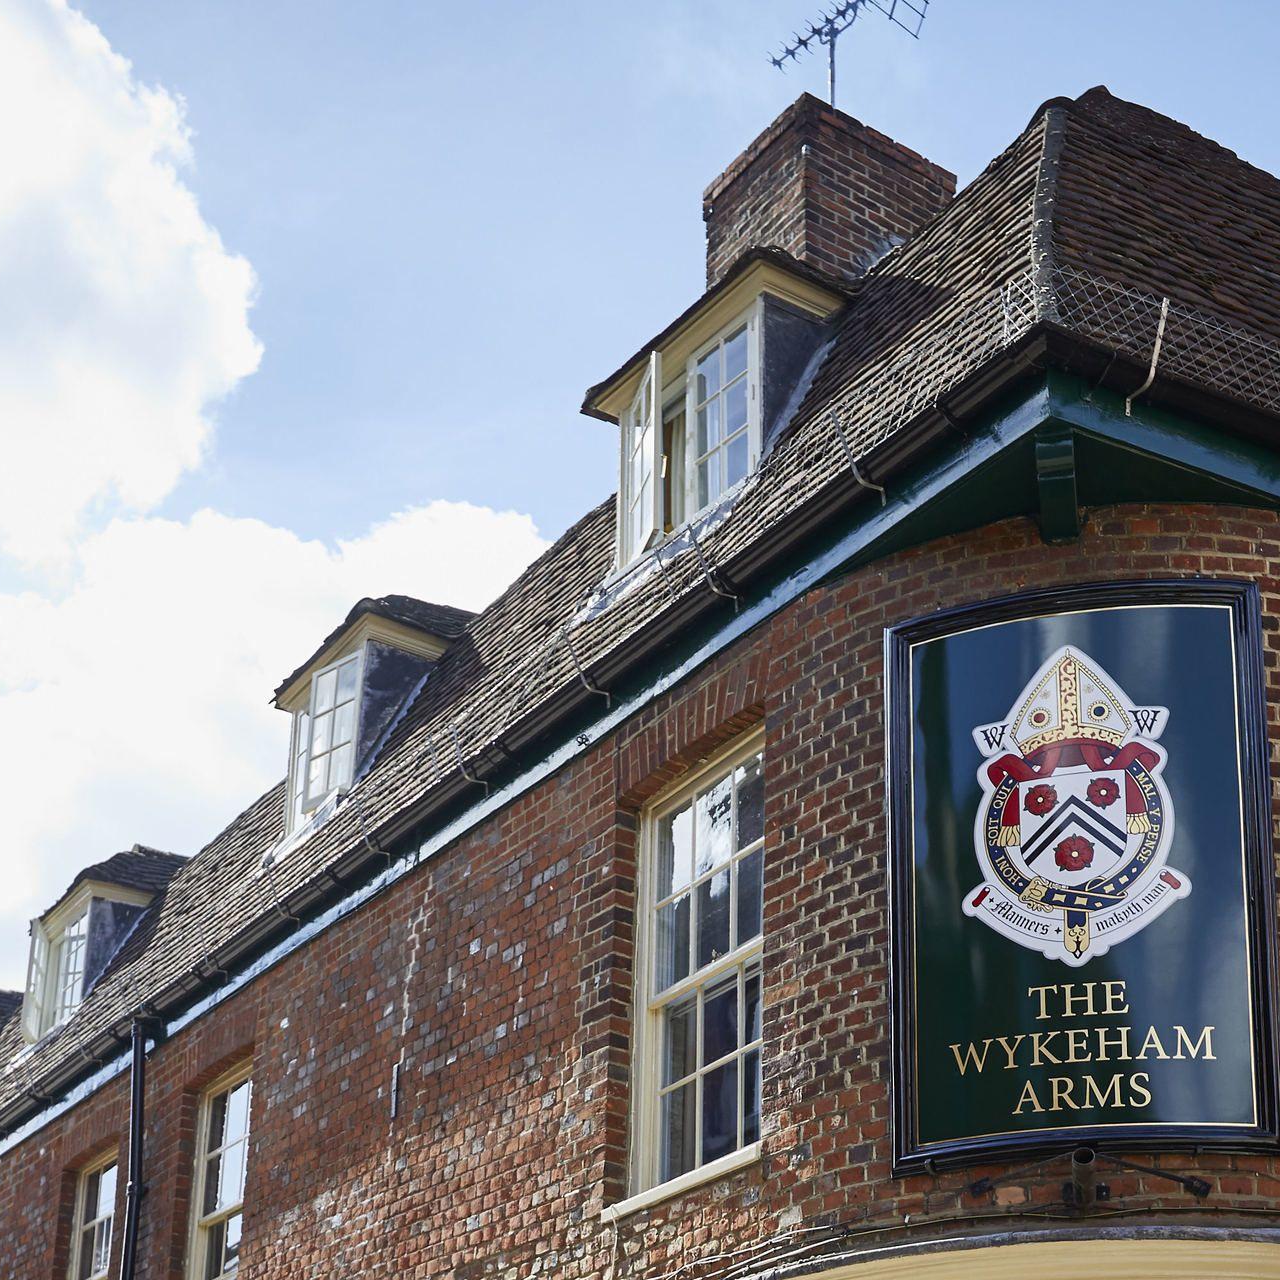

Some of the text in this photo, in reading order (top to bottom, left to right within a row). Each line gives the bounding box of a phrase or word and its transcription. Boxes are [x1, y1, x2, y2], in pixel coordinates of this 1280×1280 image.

[980, 723, 1009, 750] W
[1128, 709, 1161, 733] W
[993, 784, 1011, 809] QUI
[1135, 771, 1153, 800] MAL
[988, 817, 1001, 847] SOIT
[1136, 824, 1160, 864] PENSE
[994, 854, 1019, 886] HONI
[991, 883, 1167, 936] Manners makyth man
[1028, 980, 1129, 1020] THE
[949, 1025, 1217, 1076] WYKEHAM
[1012, 1072, 1152, 1115] ARMS
